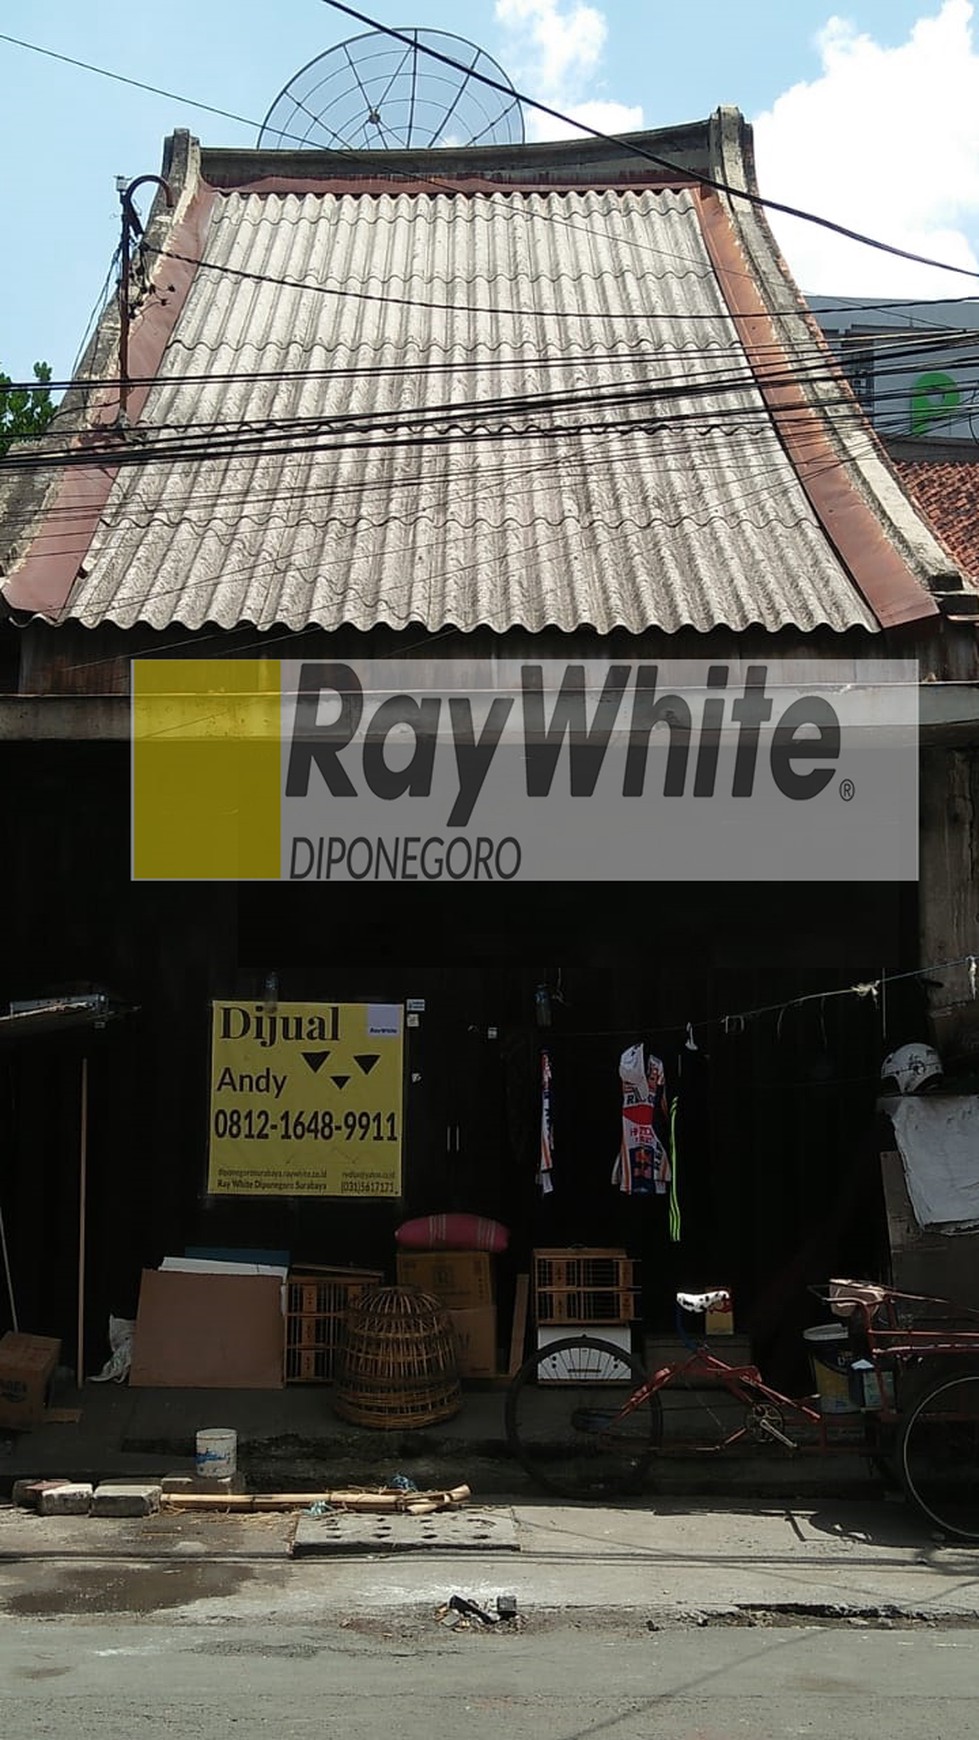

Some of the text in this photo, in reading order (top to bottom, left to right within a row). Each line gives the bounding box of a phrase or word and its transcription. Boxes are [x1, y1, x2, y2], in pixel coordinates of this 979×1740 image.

[219, 1005, 340, 1047] Dijual
[216, 1067, 288, 1098] Andy
[214, 1109, 398, 1141] 0812-1648-9911
